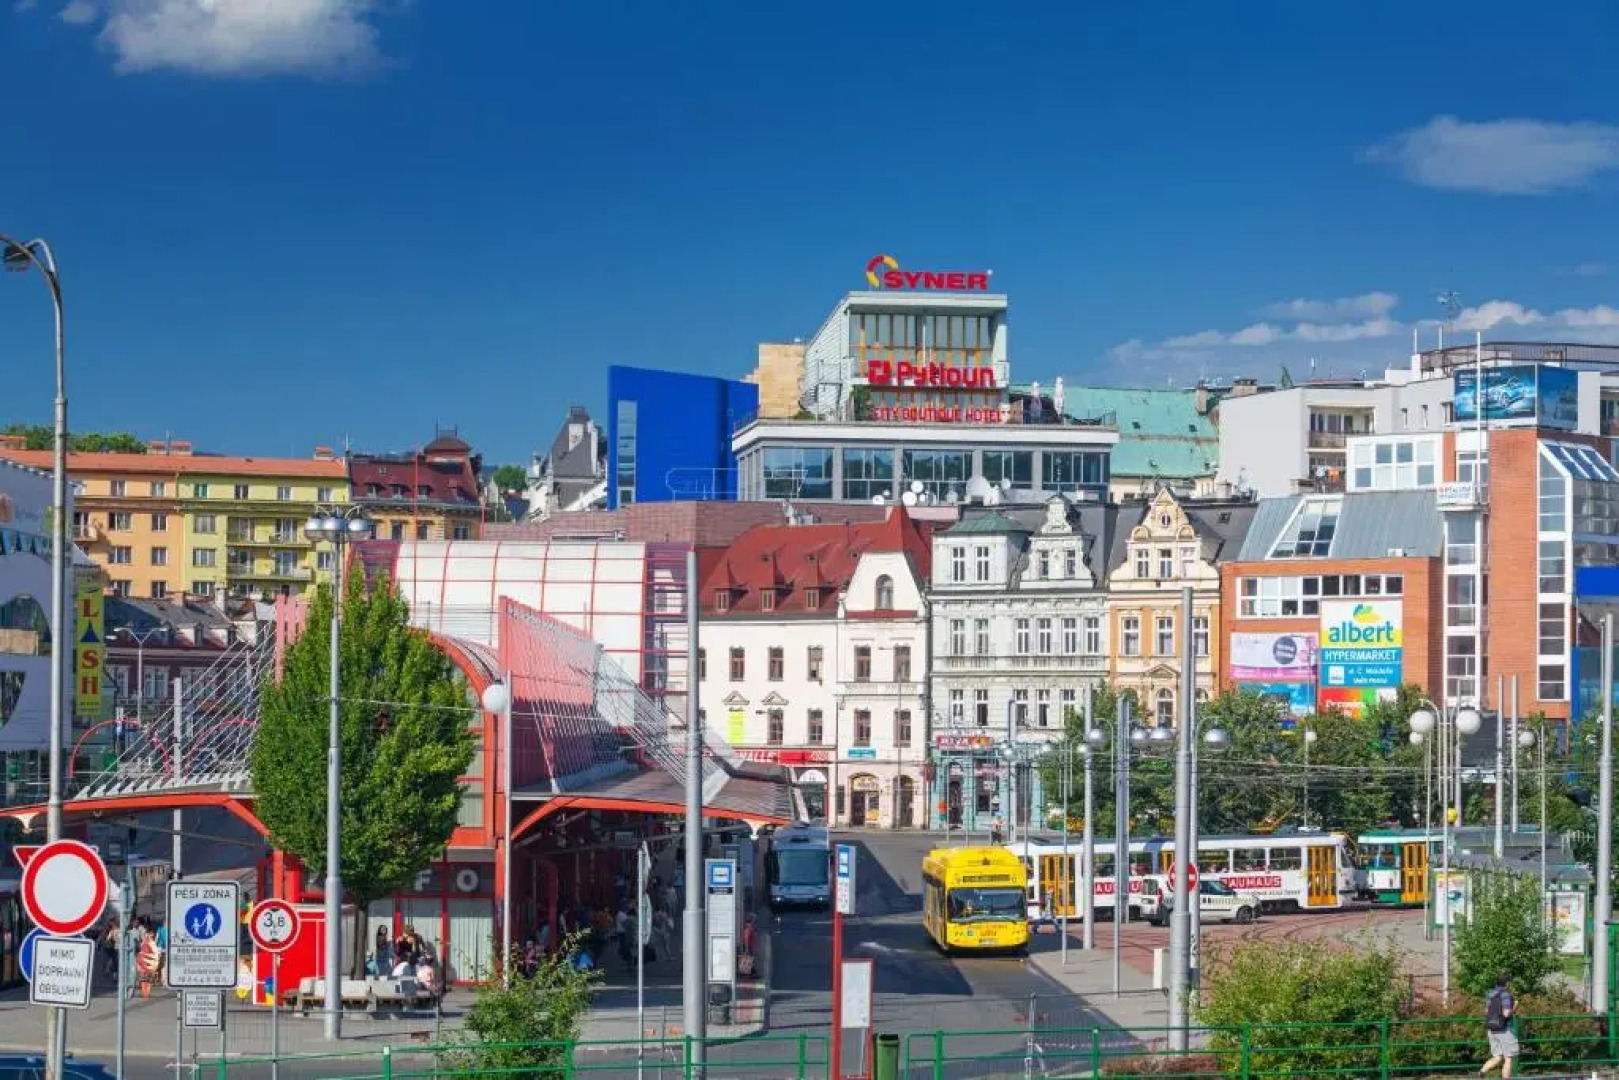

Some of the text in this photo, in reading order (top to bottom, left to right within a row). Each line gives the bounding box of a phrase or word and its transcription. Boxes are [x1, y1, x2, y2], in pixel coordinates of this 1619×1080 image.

[884, 271, 988, 290] SYNER
[897, 361, 997, 387] Pytloun
[1328, 620, 1394, 642] albert
[1324, 649, 1397, 662] HYPERMARKET
[50, 948, 76, 960] MIMO
